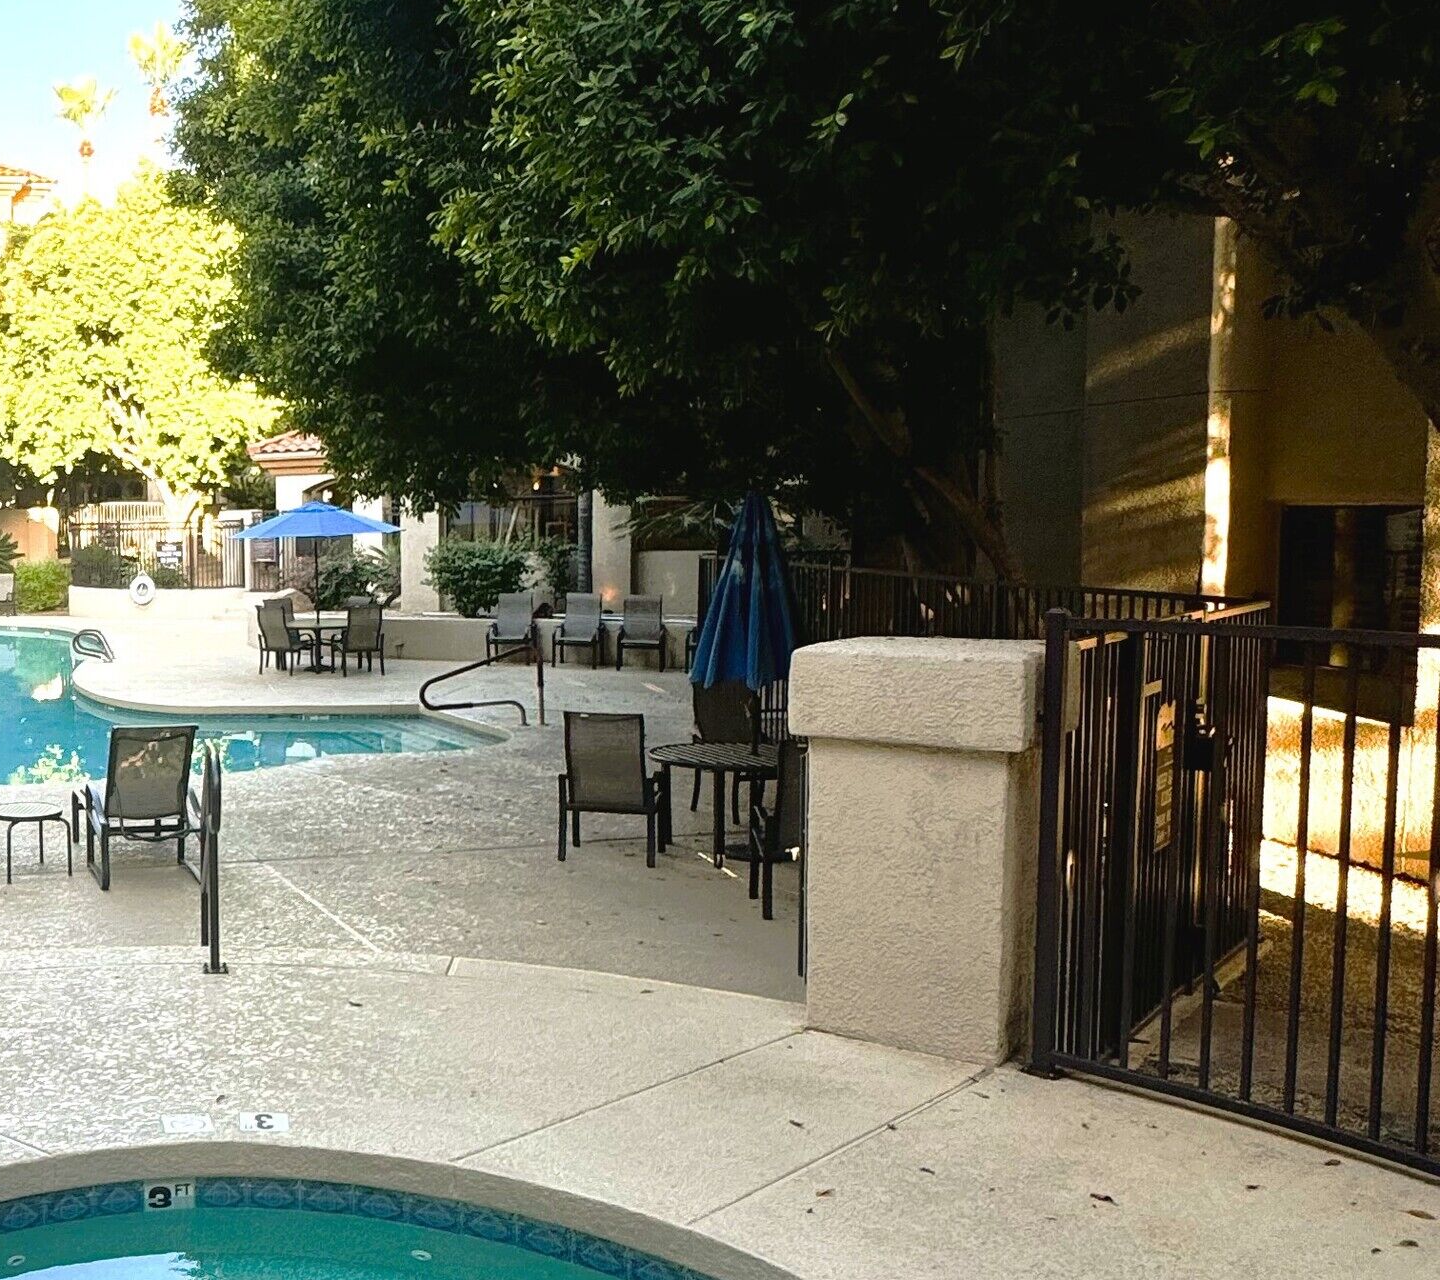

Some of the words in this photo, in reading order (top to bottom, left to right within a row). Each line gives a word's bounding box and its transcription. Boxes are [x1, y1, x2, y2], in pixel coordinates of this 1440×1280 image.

[255, 1114, 274, 1129] 3
[148, 1186, 172, 1208] 3
[175, 1183, 191, 1195] FT
